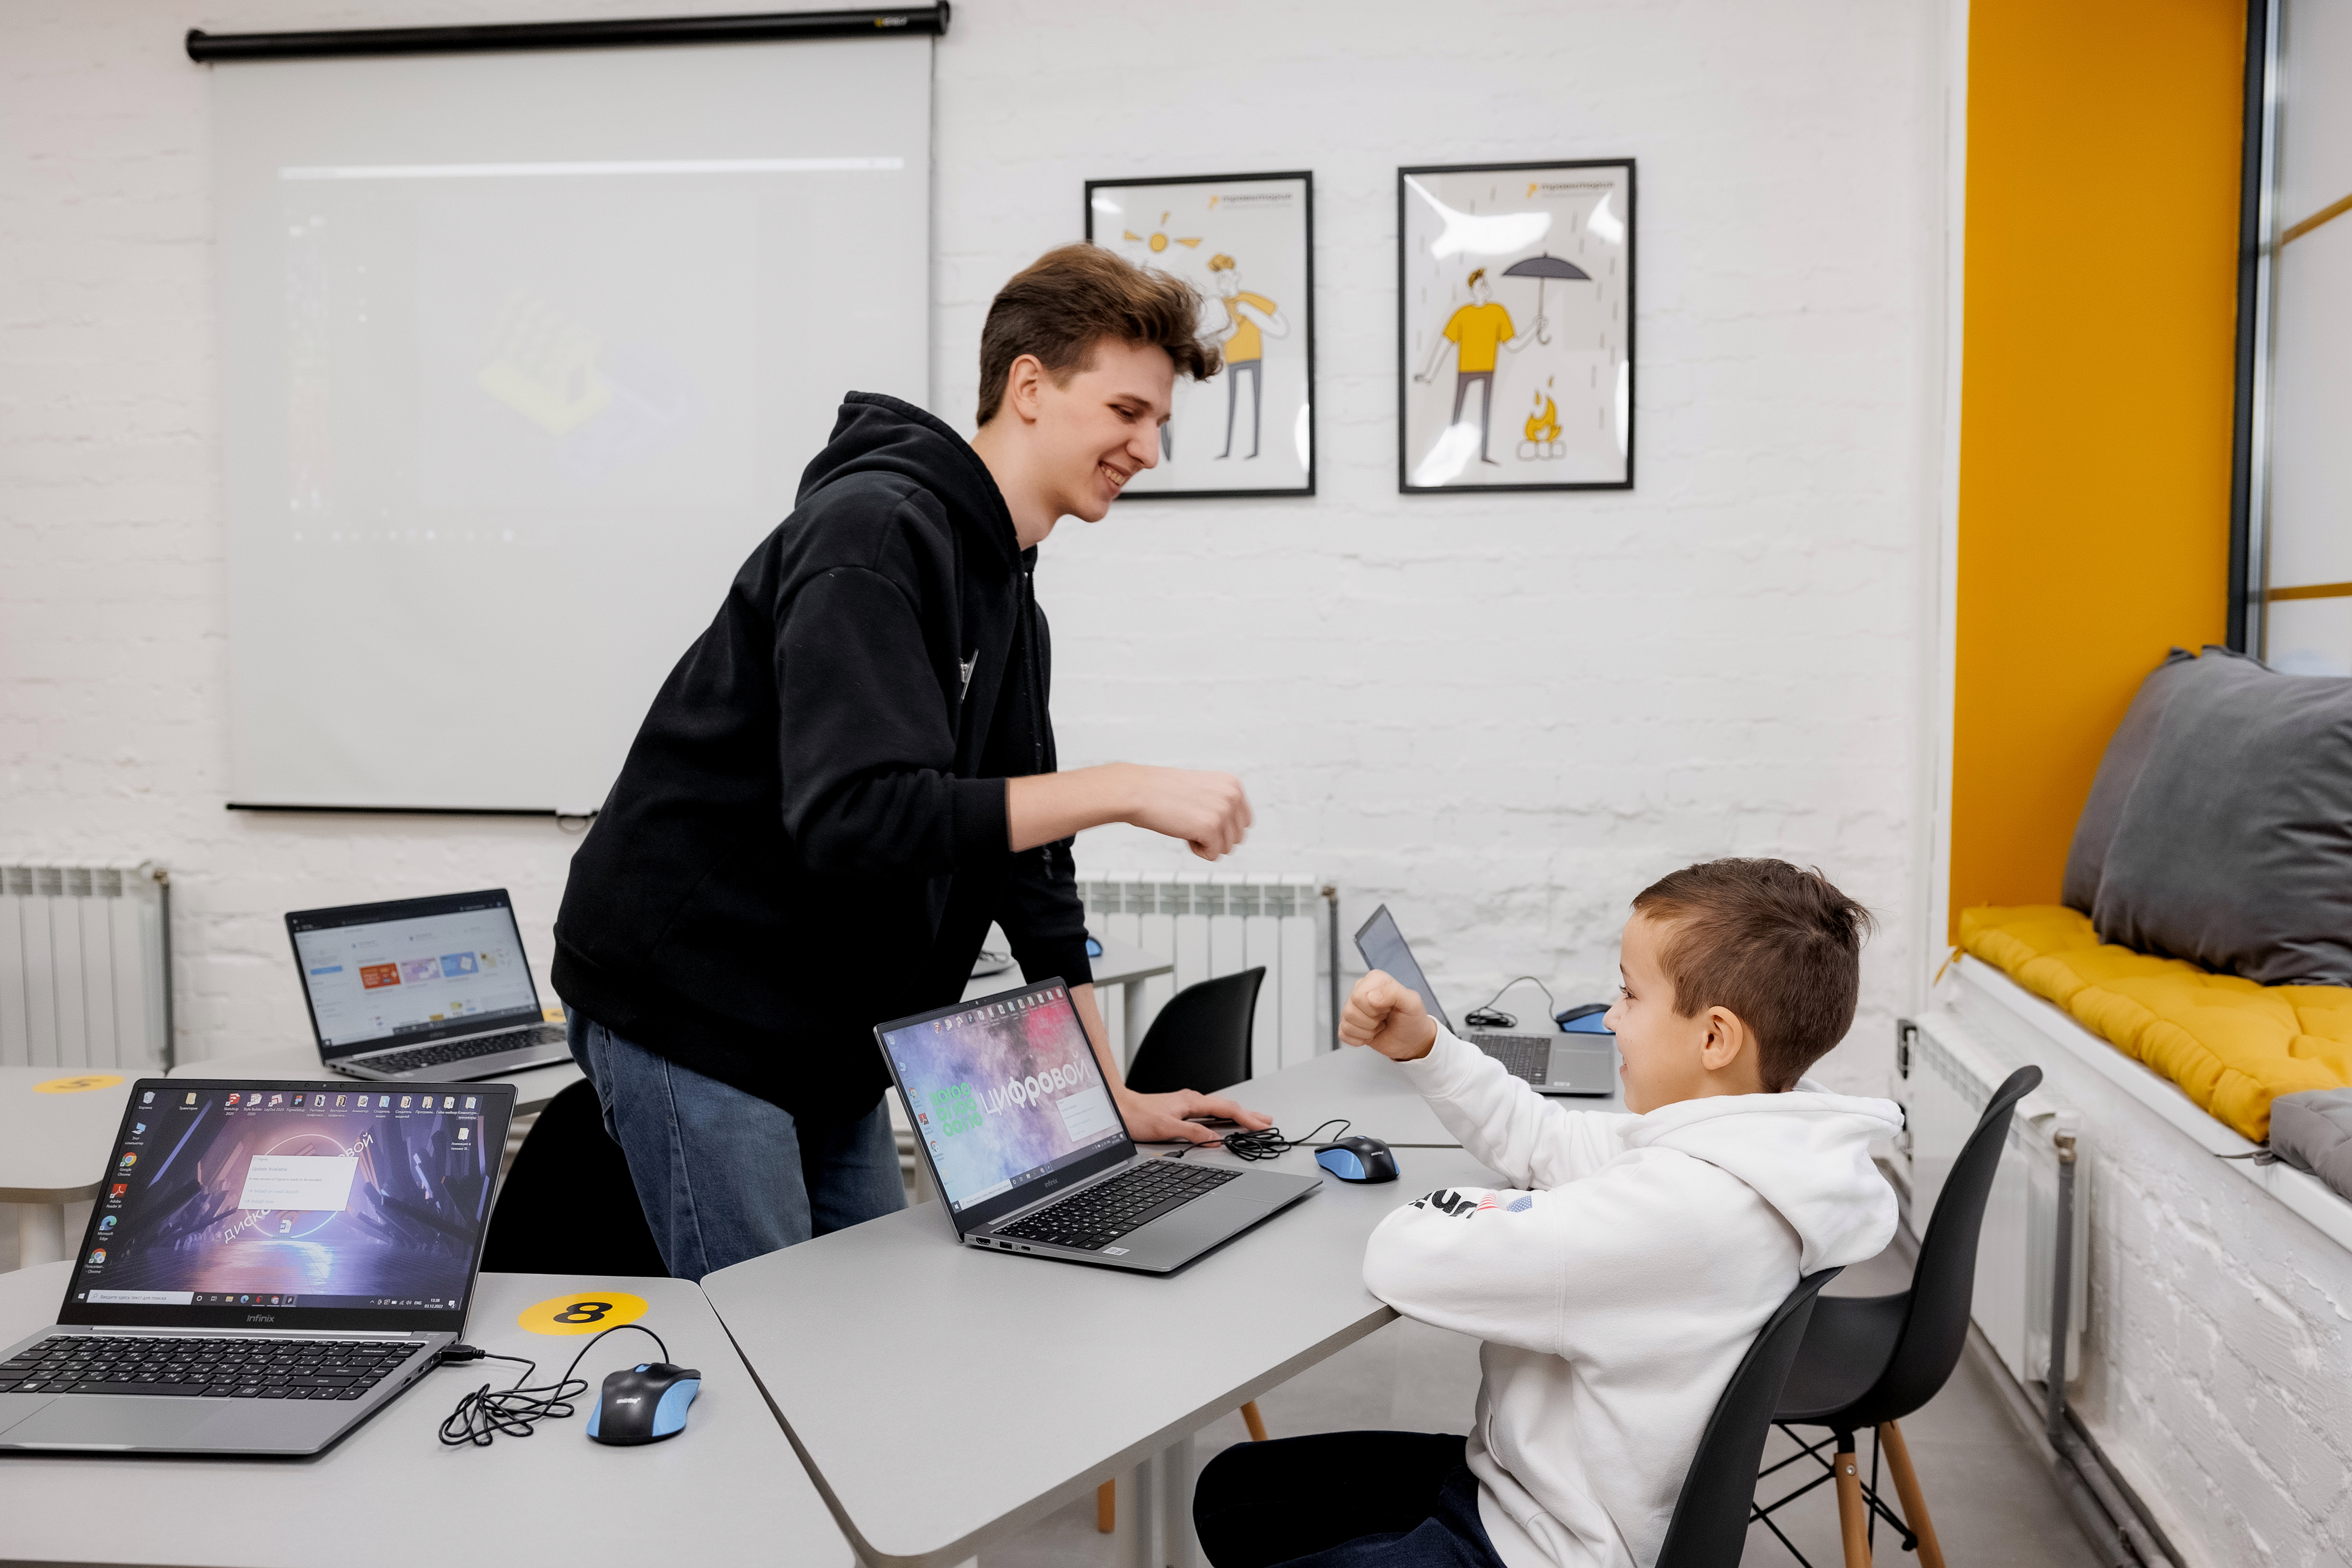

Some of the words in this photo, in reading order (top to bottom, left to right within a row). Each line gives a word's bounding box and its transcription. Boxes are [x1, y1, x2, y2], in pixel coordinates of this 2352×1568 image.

[980, 1051, 1091, 1116] ЦИФРОВОЙ
[337, 1132, 373, 1157] ВОЙ
[1045, 1178, 1058, 1188] Infinix
[247, 1314, 275, 1323] Infinix
[553, 1302, 613, 1324] 8
